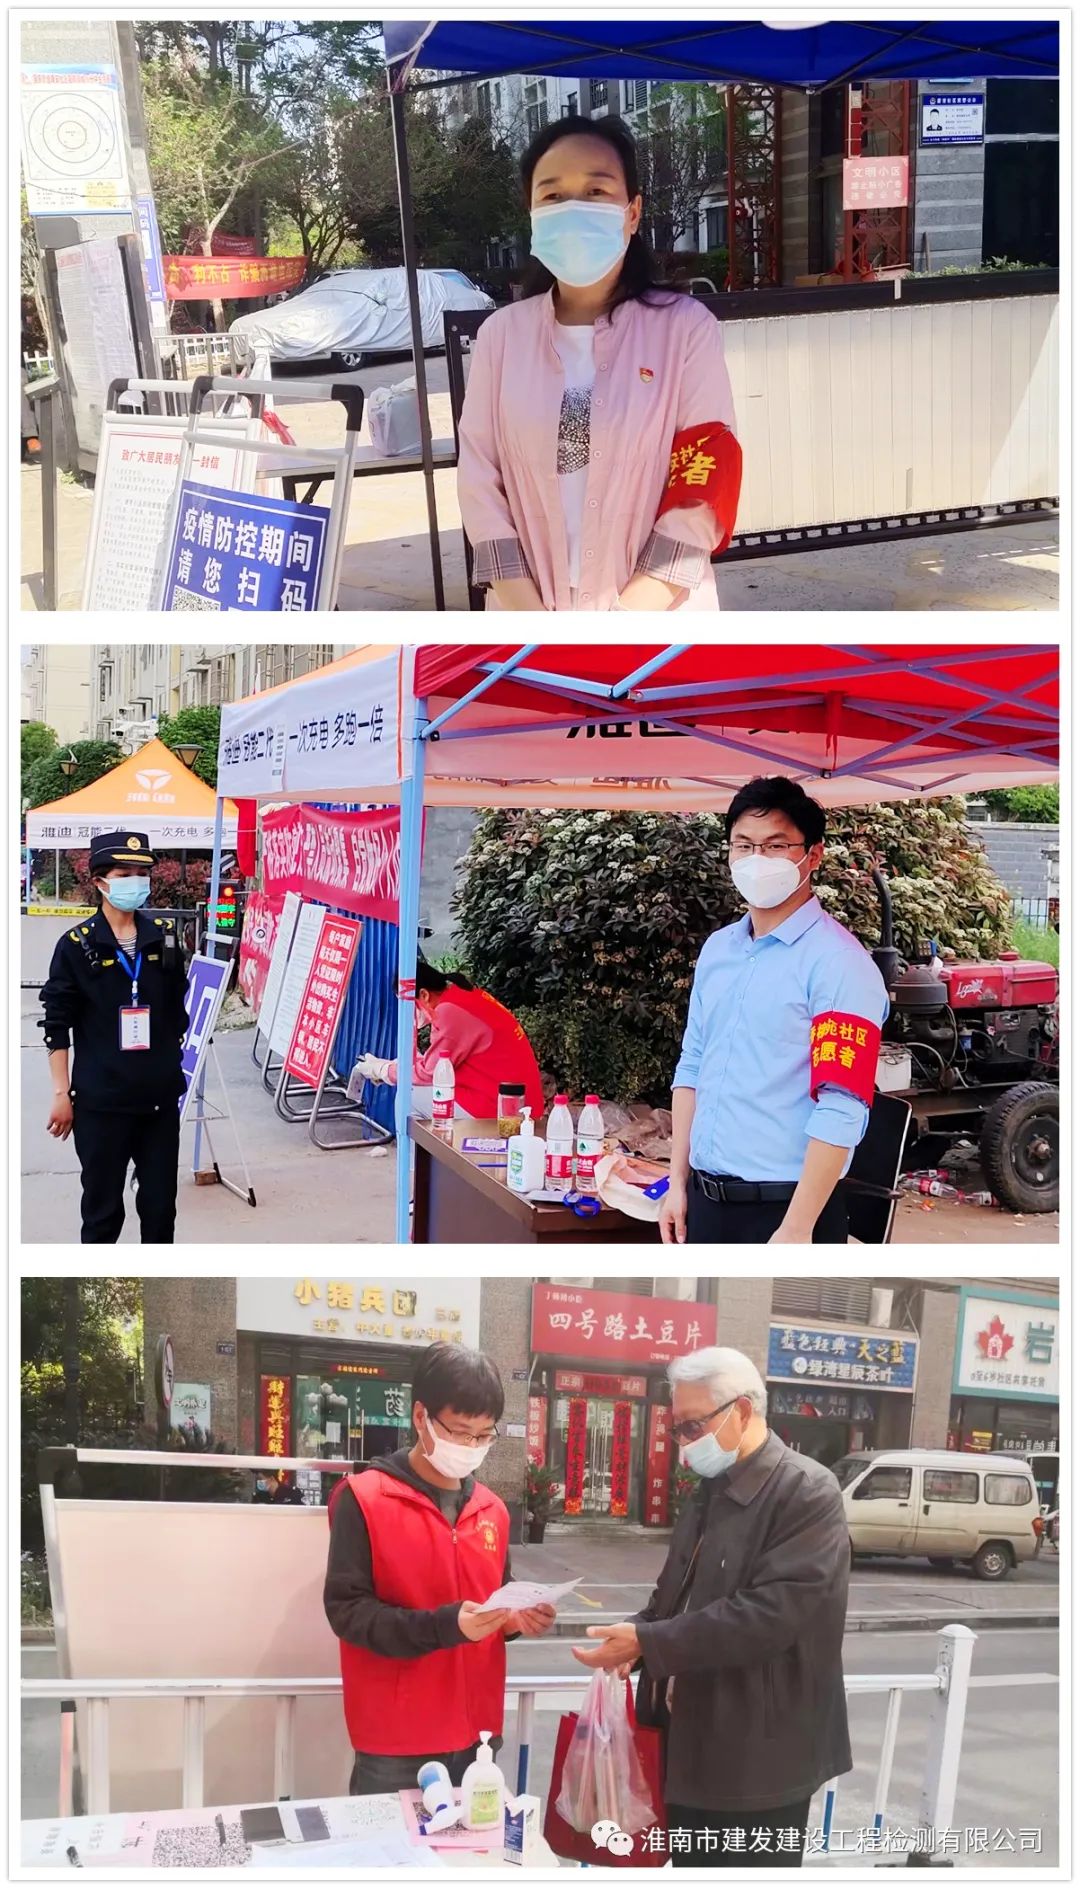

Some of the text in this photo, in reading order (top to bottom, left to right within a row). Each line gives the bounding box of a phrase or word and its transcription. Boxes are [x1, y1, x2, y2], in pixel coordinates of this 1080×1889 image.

[851, 166, 901, 178] 文明小区
[121, 449, 220, 470] 致广大居民朋友一封信
[182, 507, 314, 572] 疫情防控期间
[176, 548, 307, 611] 请您扫码
[289, 715, 329, 752] 一次充电
[332, 703, 384, 749] 多跑一倍
[41, 826, 72, 837] 雅迪
[150, 826, 198, 837] 一次充电
[294, 1277, 418, 1317] 小猪兵团
[549, 1308, 703, 1350] 四号路土豆片
[1024, 1322, 1056, 1364] 岩
